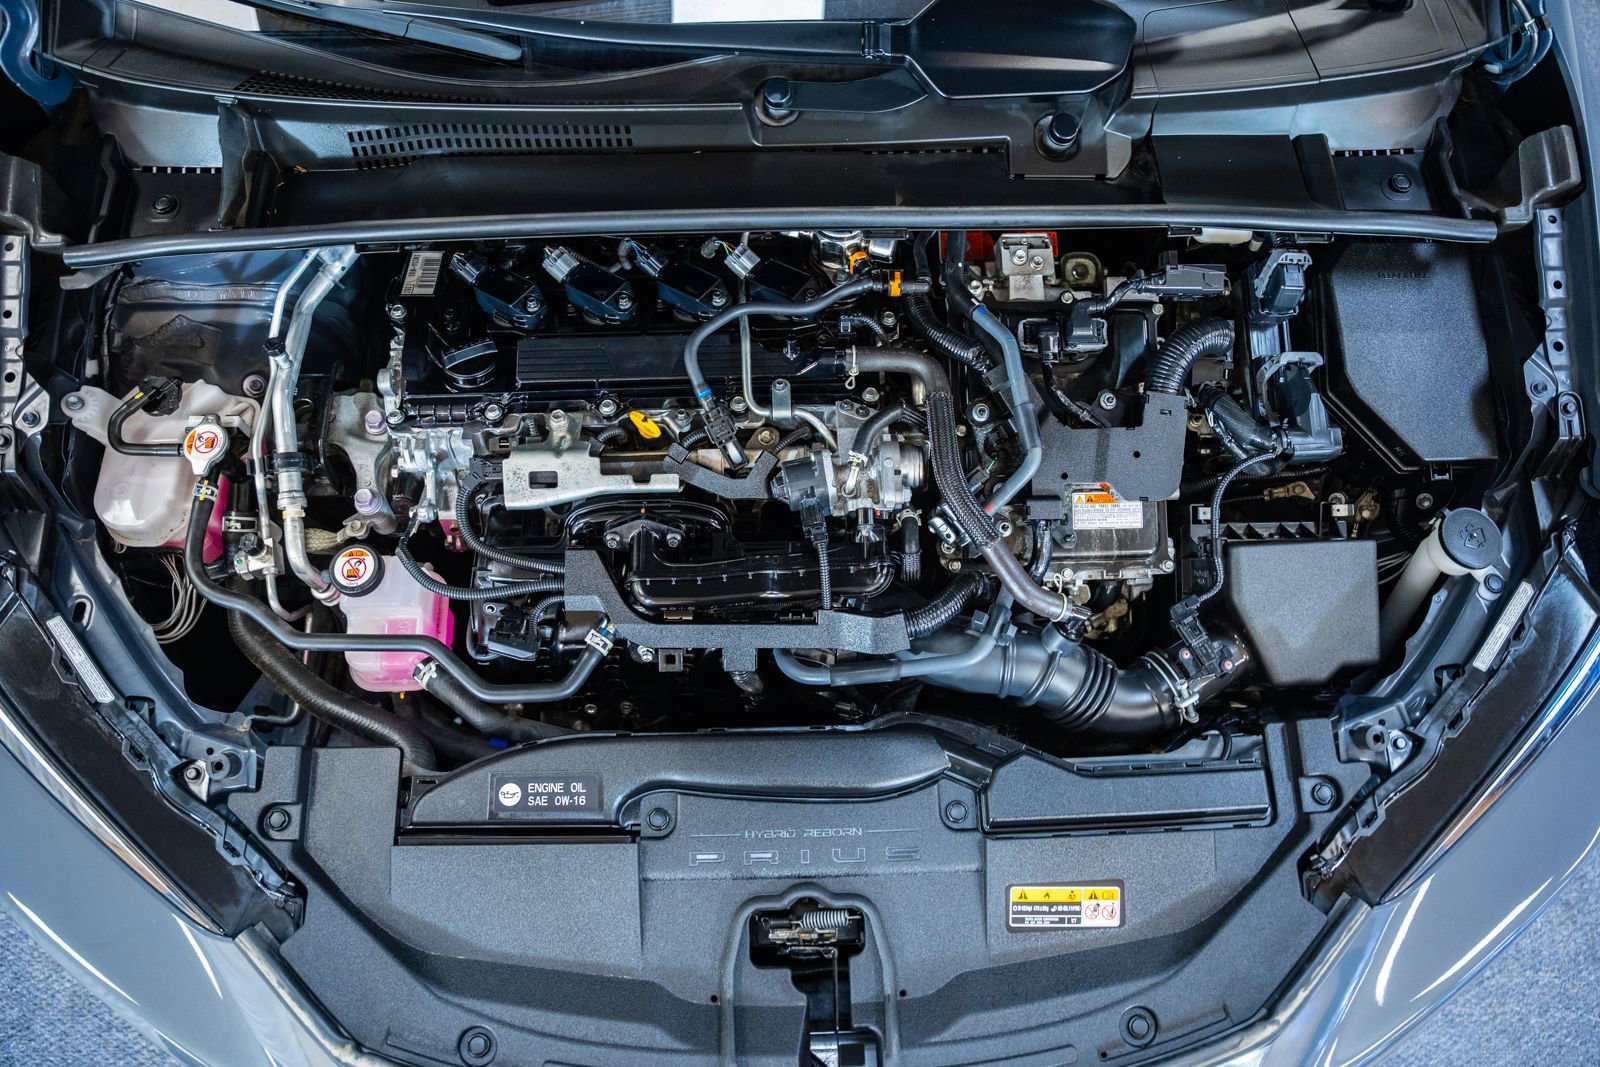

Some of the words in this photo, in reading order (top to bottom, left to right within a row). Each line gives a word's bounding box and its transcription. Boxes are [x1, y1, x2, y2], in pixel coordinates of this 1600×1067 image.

[528, 783, 564, 792] ENGINE
[570, 783, 586, 792] OIL
[528, 796, 548, 806] SAE
[555, 796, 586, 806] 0W-16
[745, 829, 796, 838] HYBRID
[804, 827, 862, 838] REBORN
[689, 846, 921, 867] PRIUS
